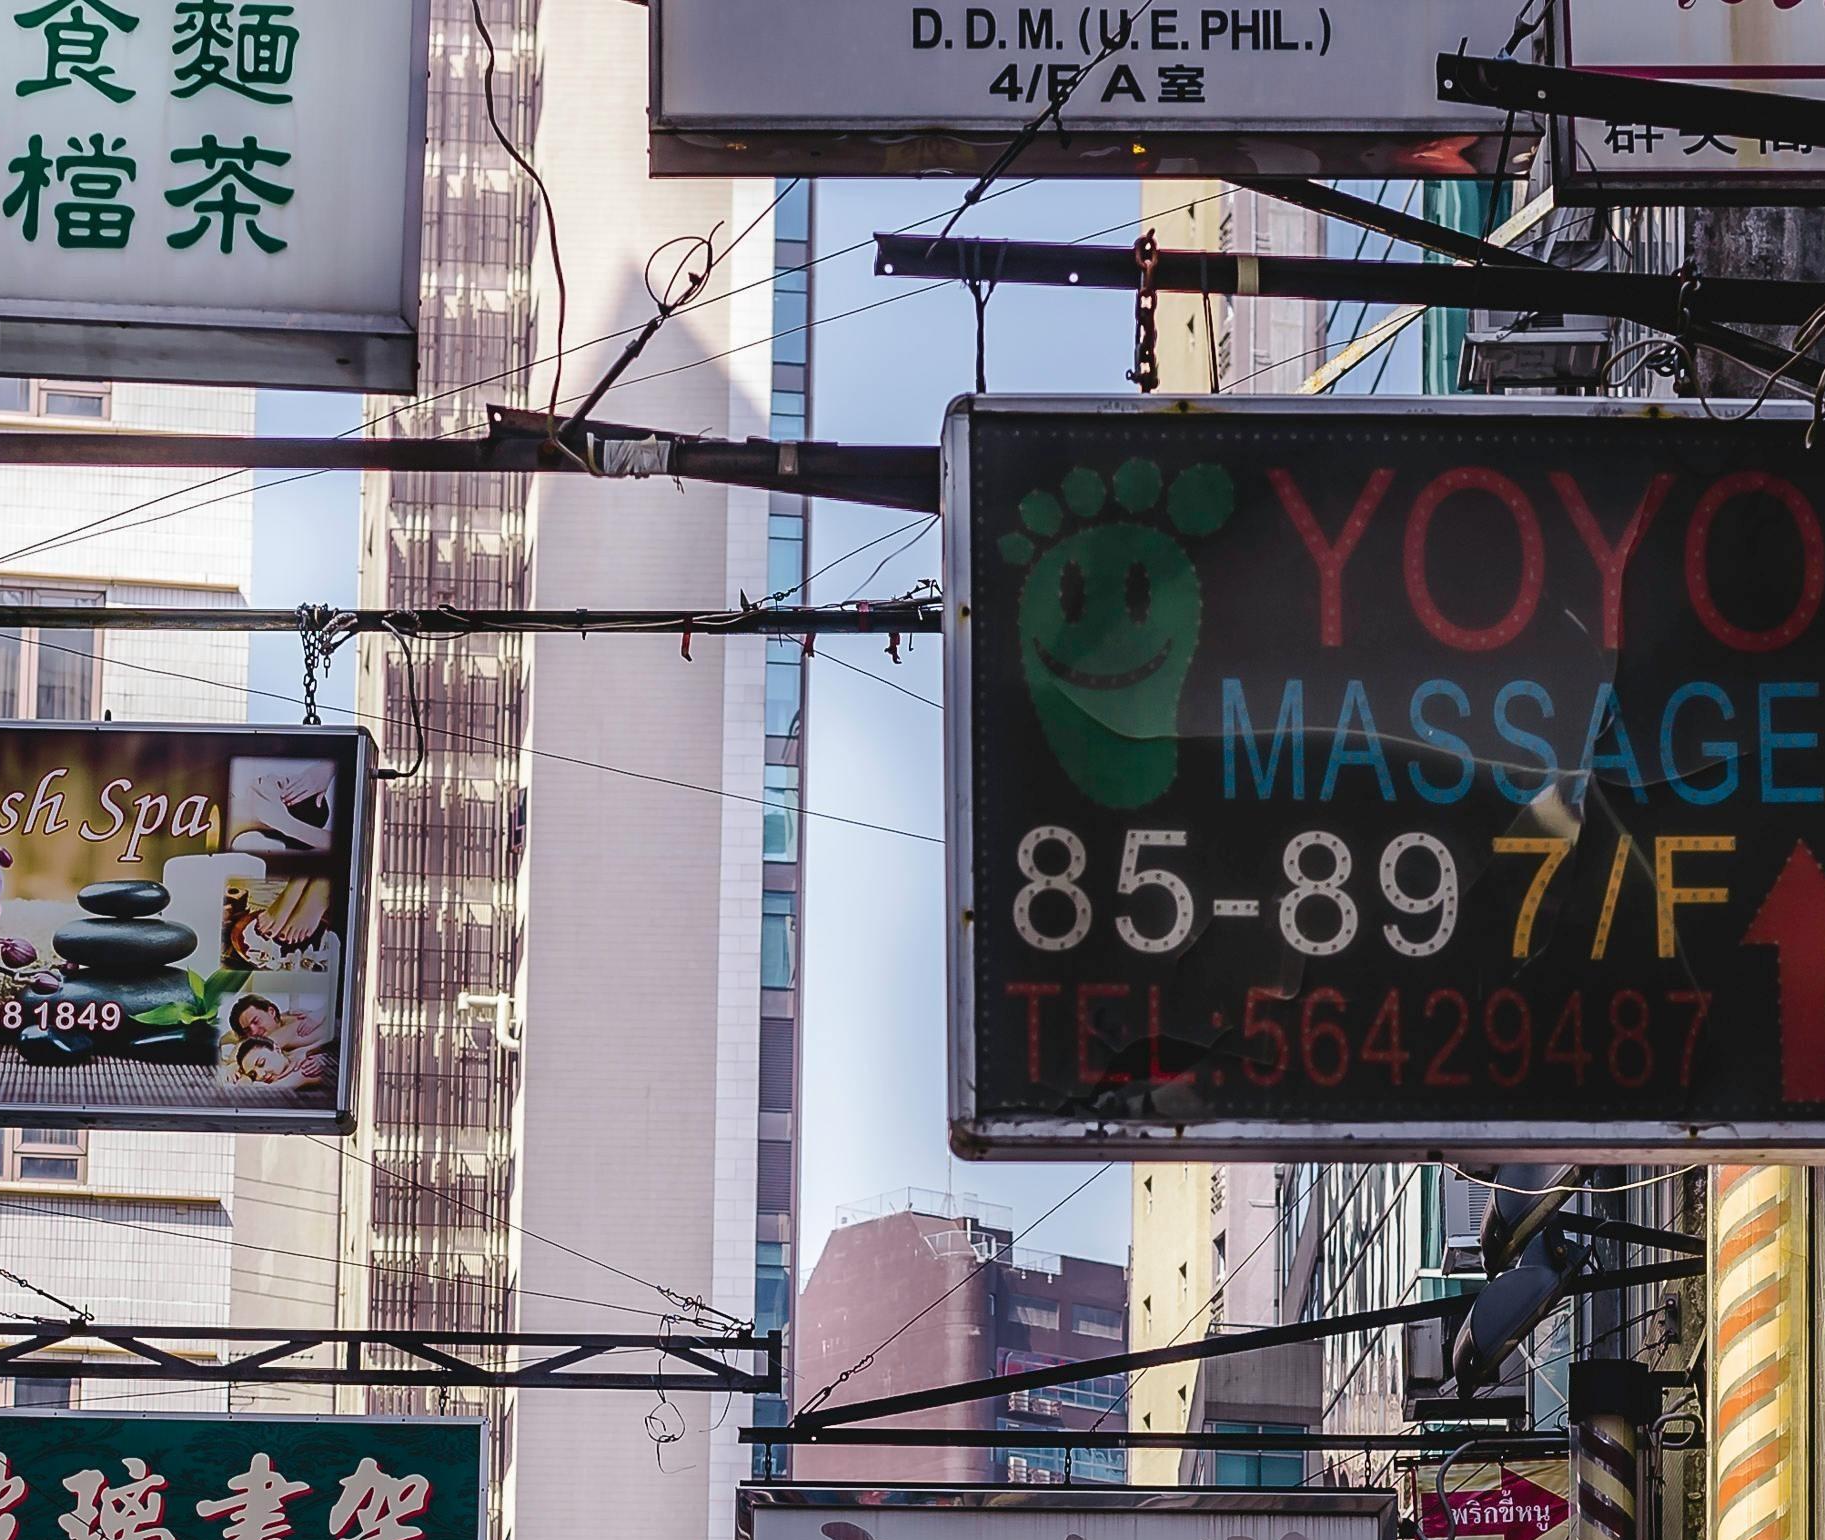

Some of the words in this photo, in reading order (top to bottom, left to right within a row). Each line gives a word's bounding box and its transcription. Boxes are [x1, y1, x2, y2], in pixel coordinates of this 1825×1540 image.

[1201, 8, 1331, 57] PHIL.)
[1268, 466, 1825, 652] YOYO
[1222, 677, 1825, 804] MASSAGE
[79, 778, 212, 863] Spa
[1493, 833, 1736, 960] 7/F
[34, 1002, 121, 1030] 1849
